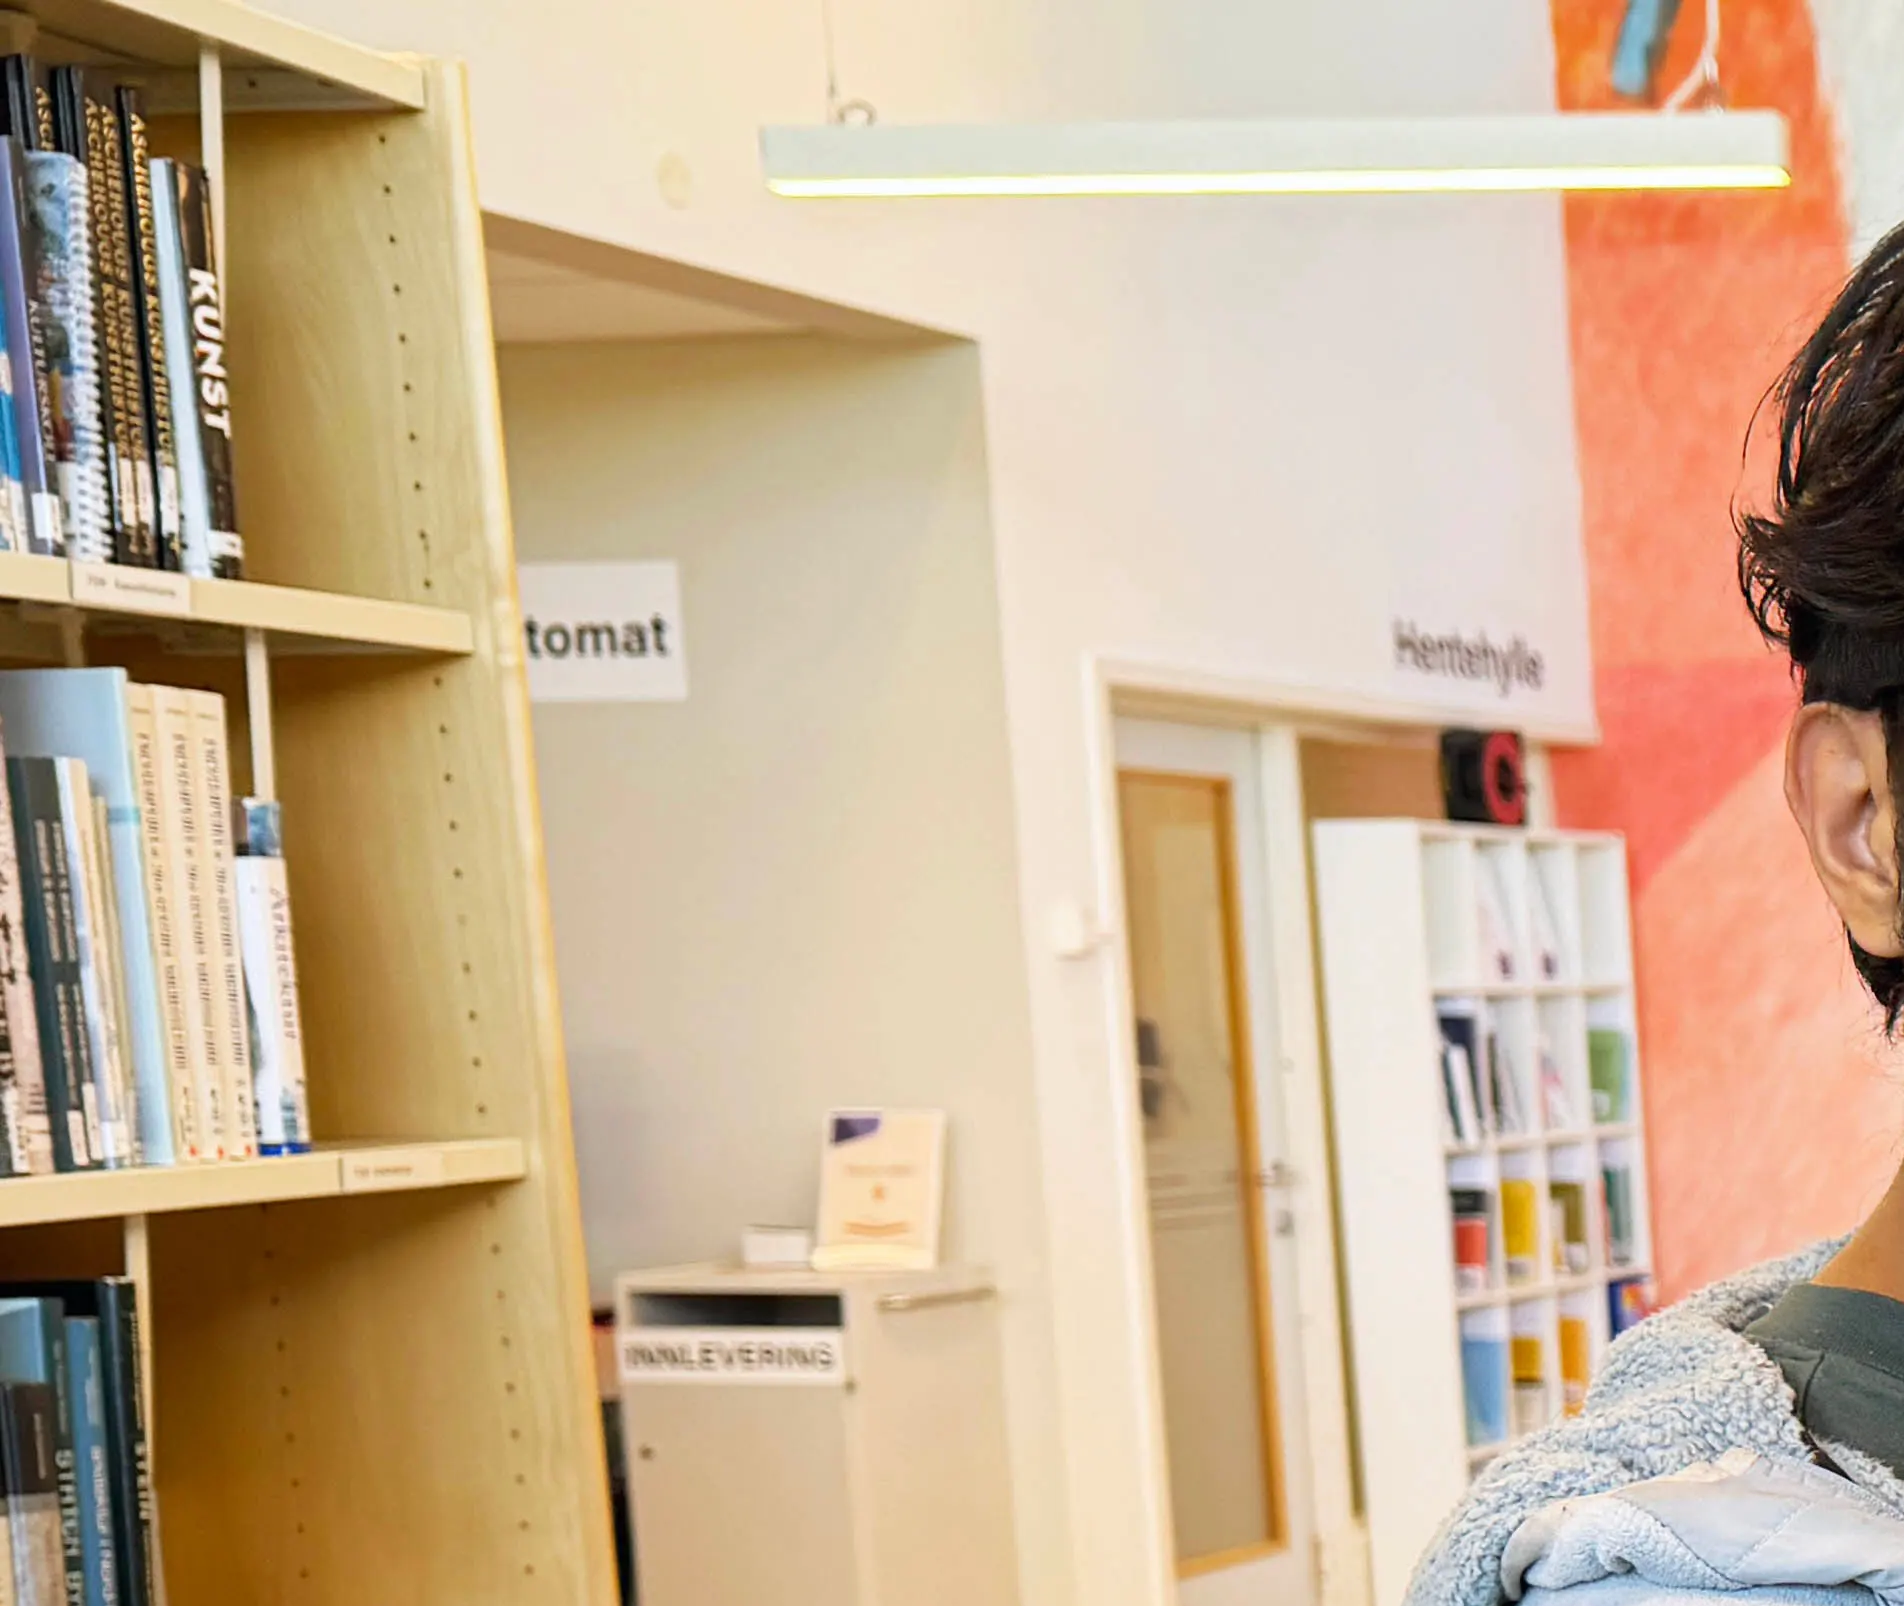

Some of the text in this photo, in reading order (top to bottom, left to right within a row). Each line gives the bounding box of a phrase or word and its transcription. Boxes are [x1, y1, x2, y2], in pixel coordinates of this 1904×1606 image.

[189, 268, 232, 439] KUNST
[525, 614, 669, 658] tomat
[1392, 615, 1544, 698] Hentehylle
[623, 1339, 836, 1371] INNLEVERING
